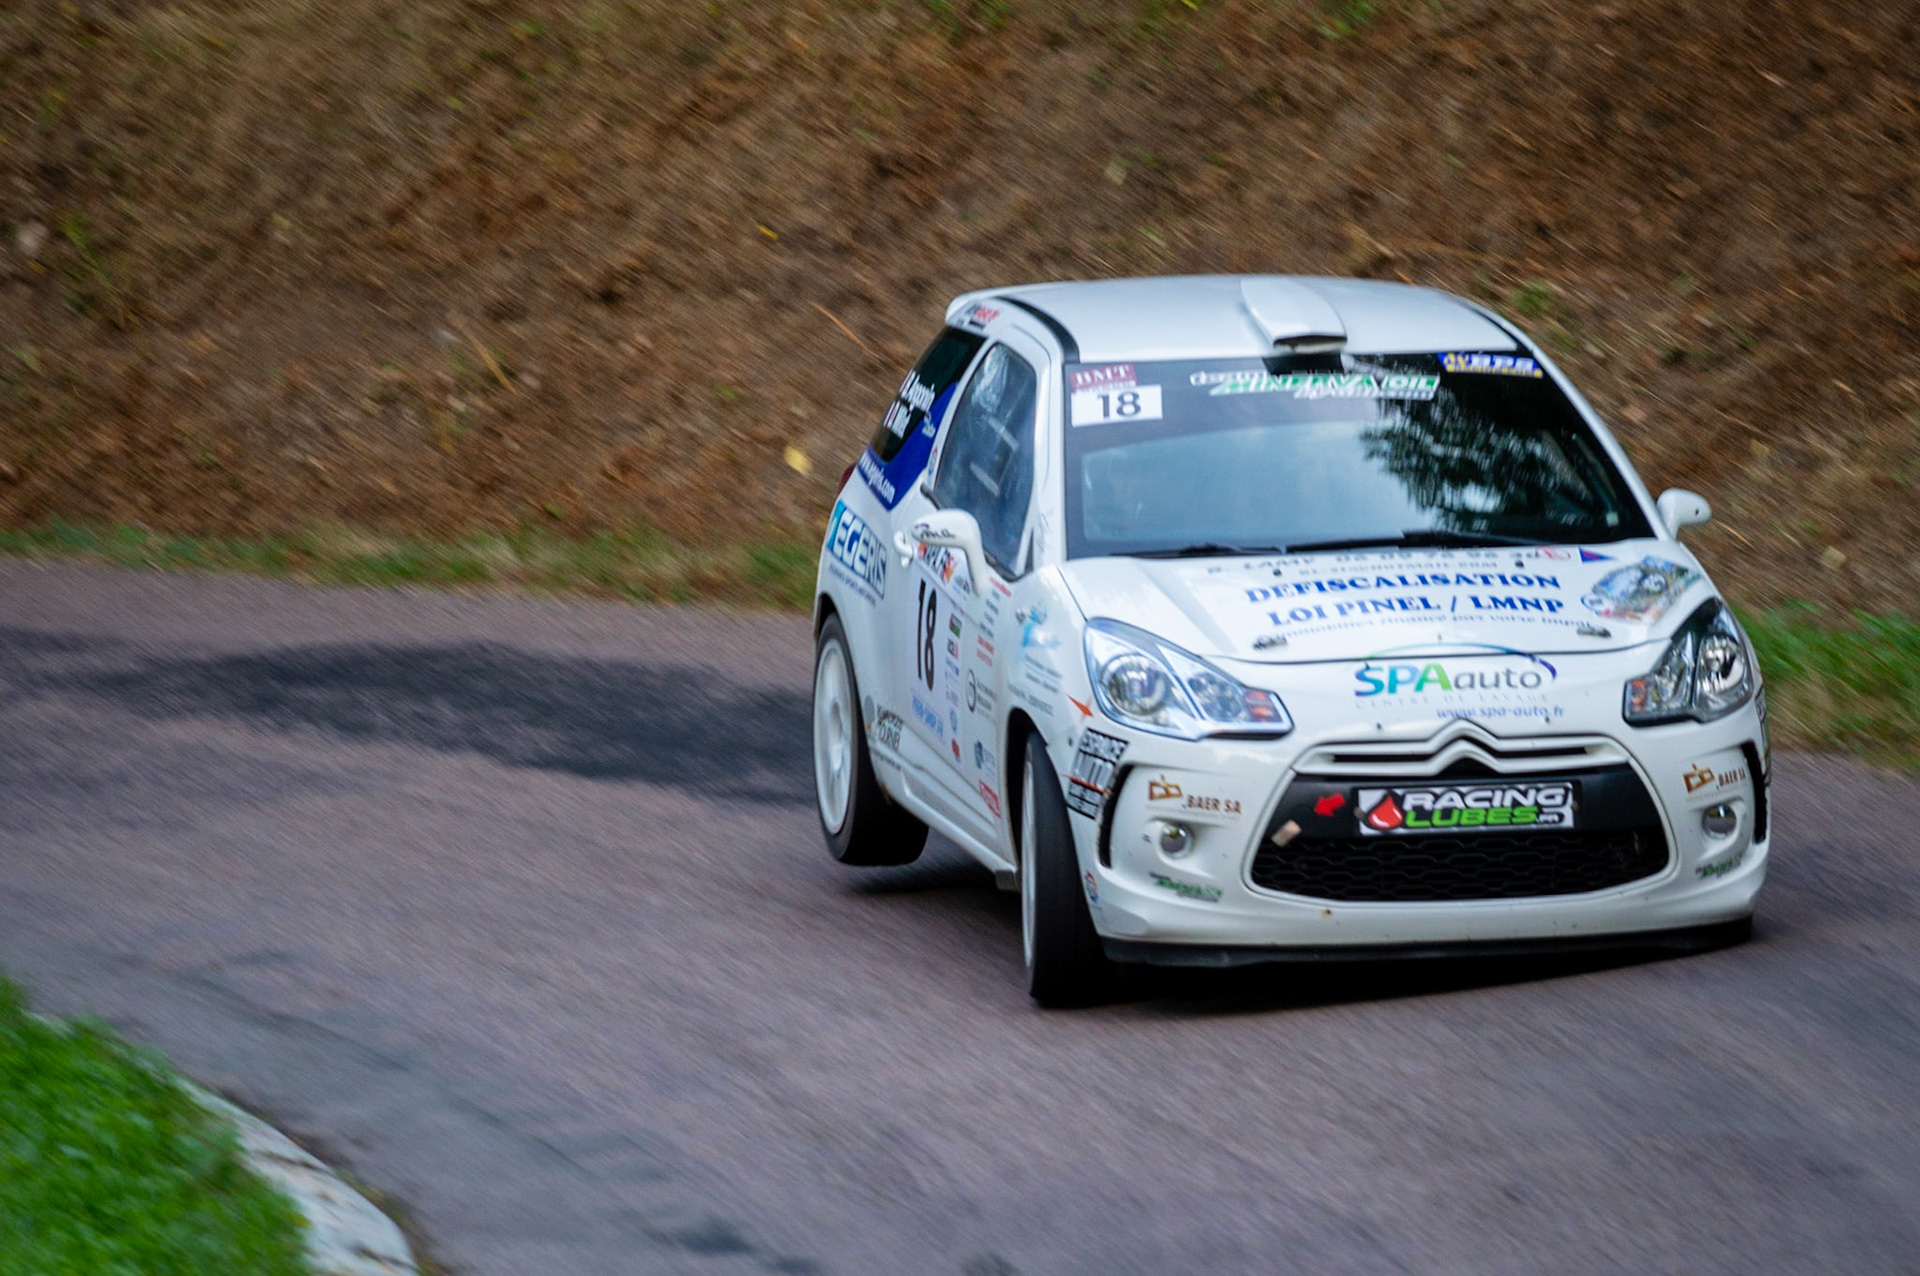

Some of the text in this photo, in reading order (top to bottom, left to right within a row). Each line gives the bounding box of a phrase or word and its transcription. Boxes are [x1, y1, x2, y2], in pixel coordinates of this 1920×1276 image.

[1097, 391, 1142, 421] 18
[1245, 572, 1561, 603] DEFISCALISATION
[1266, 604, 1328, 627] LOI
[1333, 596, 1441, 617] PINEL
[1450, 595, 1457, 613] /
[1467, 595, 1564, 613] LMNP
[917, 578, 938, 691] 18
[1436, 704, 1565, 720] www.spa-auto.fr
[1718, 771, 1738, 789] BAER
[1187, 794, 1242, 815] BAER SA
[1402, 787, 1566, 811] RACING
[1405, 805, 1539, 828] LUBES
